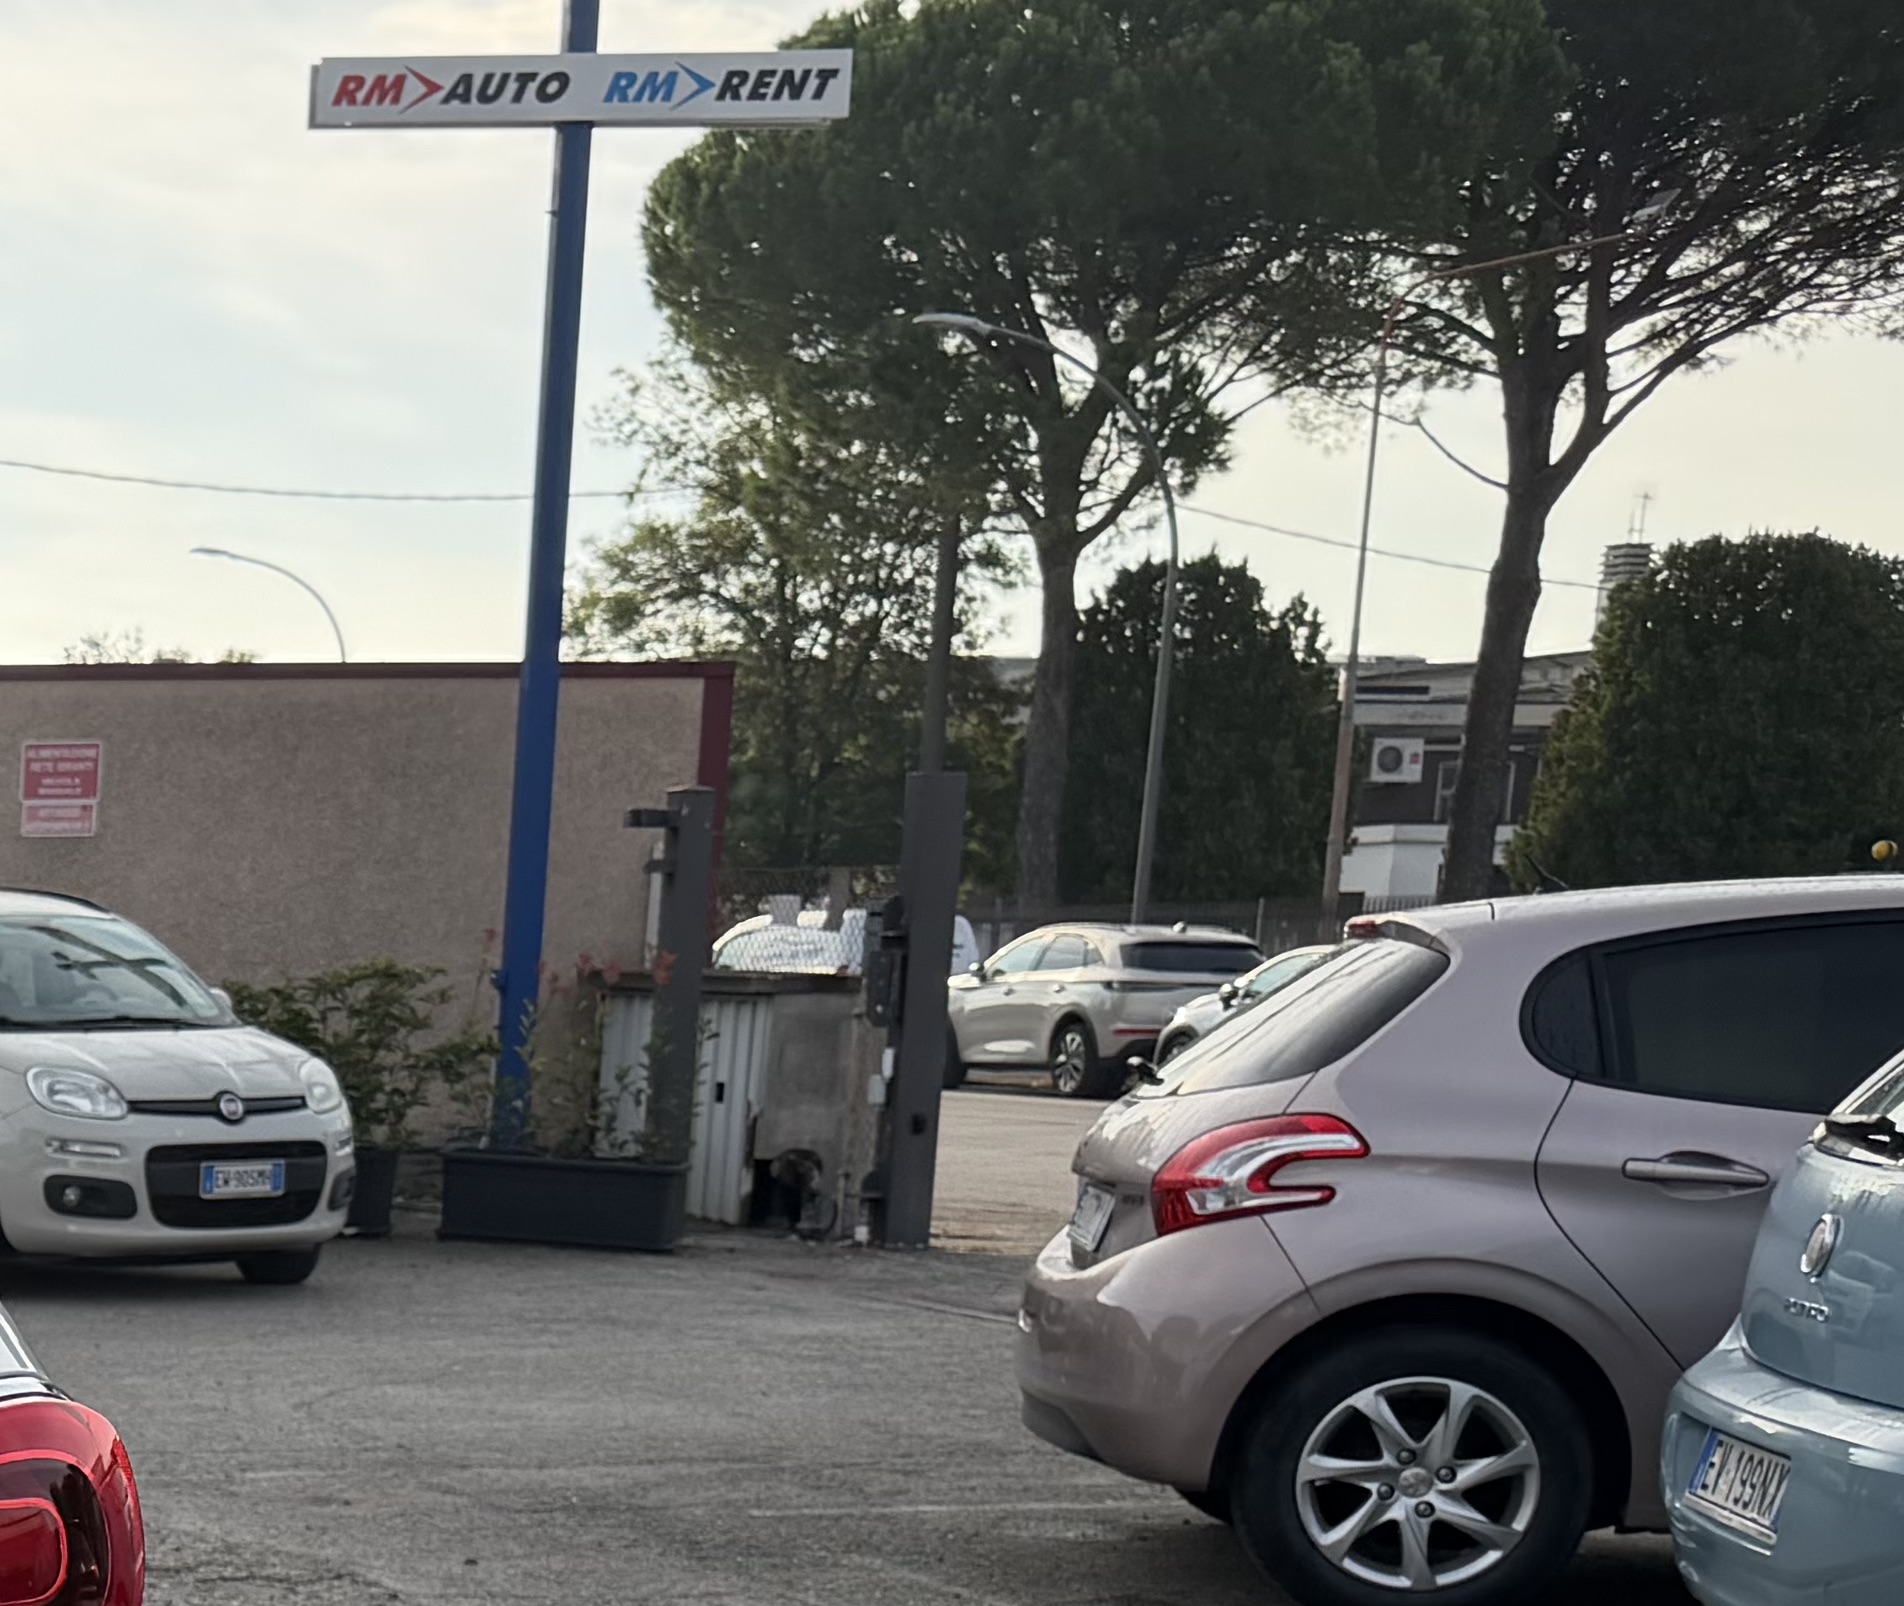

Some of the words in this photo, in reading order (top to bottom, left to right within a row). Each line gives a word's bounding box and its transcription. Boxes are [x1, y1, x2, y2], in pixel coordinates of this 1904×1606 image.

[331, 75, 407, 107] RM
[439, 71, 571, 105] AUTO
[603, 70, 680, 104] RM
[713, 68, 840, 102] RENT
